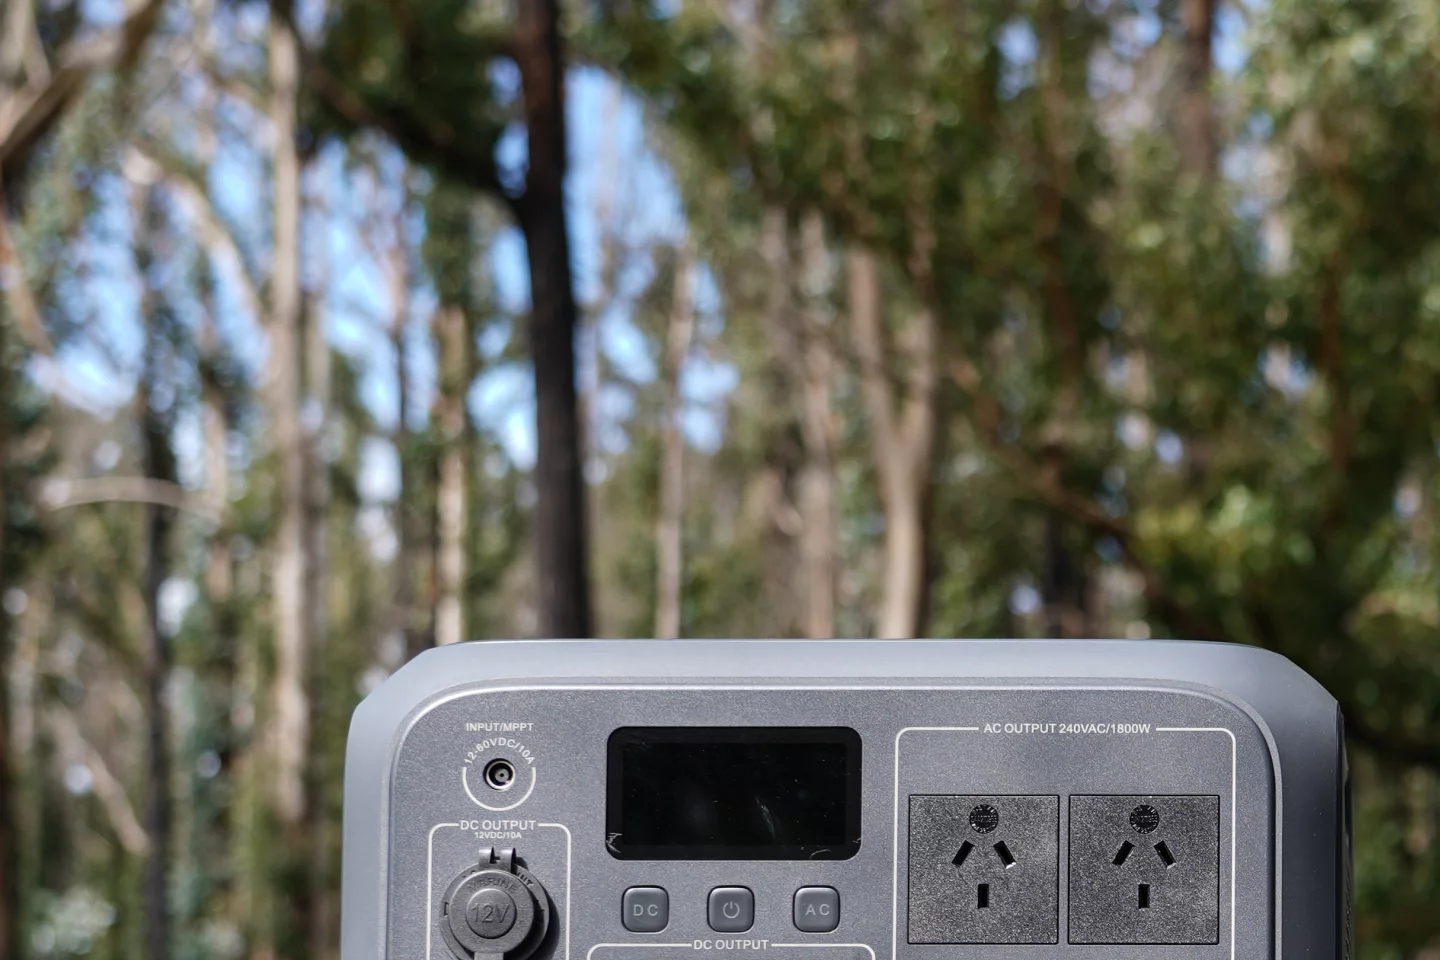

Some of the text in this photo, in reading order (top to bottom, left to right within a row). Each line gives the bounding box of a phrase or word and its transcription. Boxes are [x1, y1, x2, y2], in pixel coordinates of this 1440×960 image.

[466, 723, 534, 732] INPUT/MPPT
[984, 724, 1150, 734] AC OUTPUT 240VAC/1800W
[464, 737, 536, 764] 12-60VDC/10A
[460, 821, 536, 830] DC OUTPUT
[472, 903, 510, 923] 12V
[633, 905, 658, 916] DC
[806, 904, 830, 916] AC
[693, 940, 769, 950] DC OUTPUT
